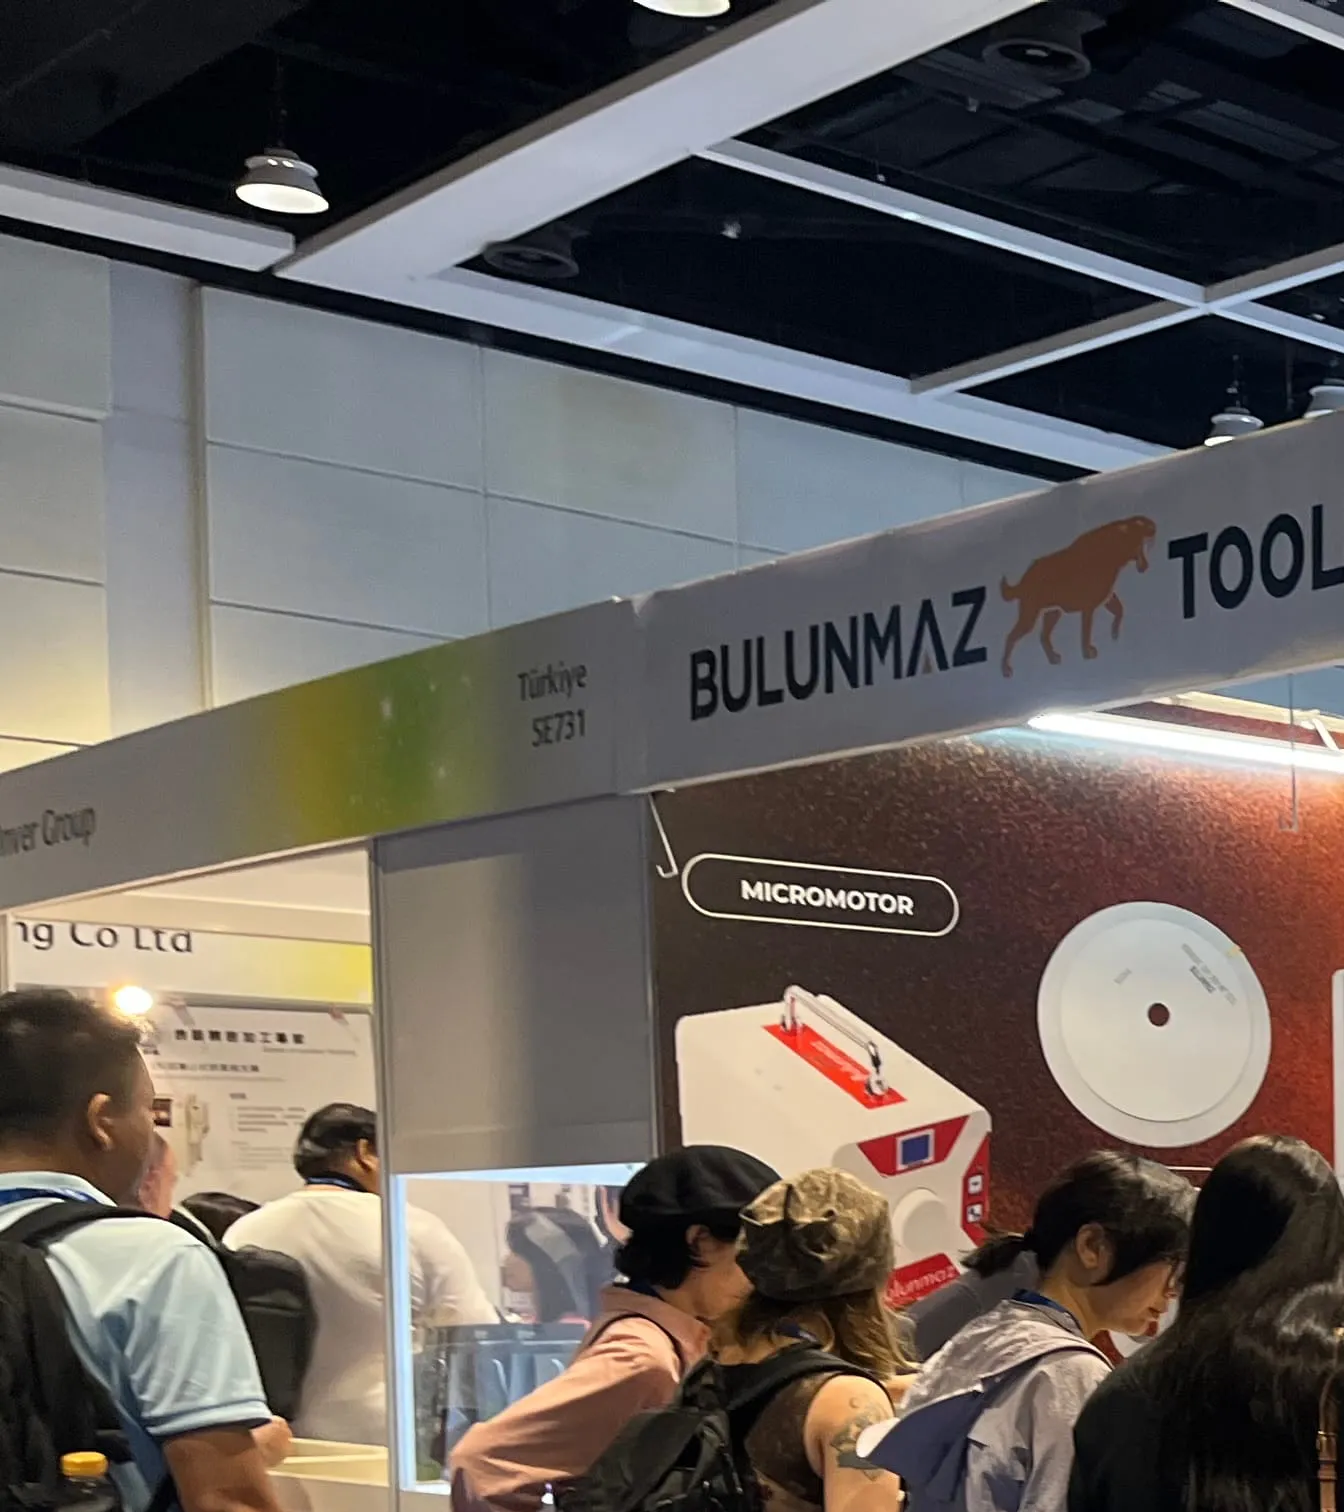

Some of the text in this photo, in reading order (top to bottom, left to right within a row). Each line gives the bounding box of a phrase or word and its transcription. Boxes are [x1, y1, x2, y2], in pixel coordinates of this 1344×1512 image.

[689, 586, 988, 720] BULUNMAZ
[517, 660, 587, 701] Türkiye
[42, 807, 95, 847] Group
[740, 879, 914, 917] MICROMOTOR
[70, 922, 118, 948] Co
[134, 927, 193, 952] Ltd
